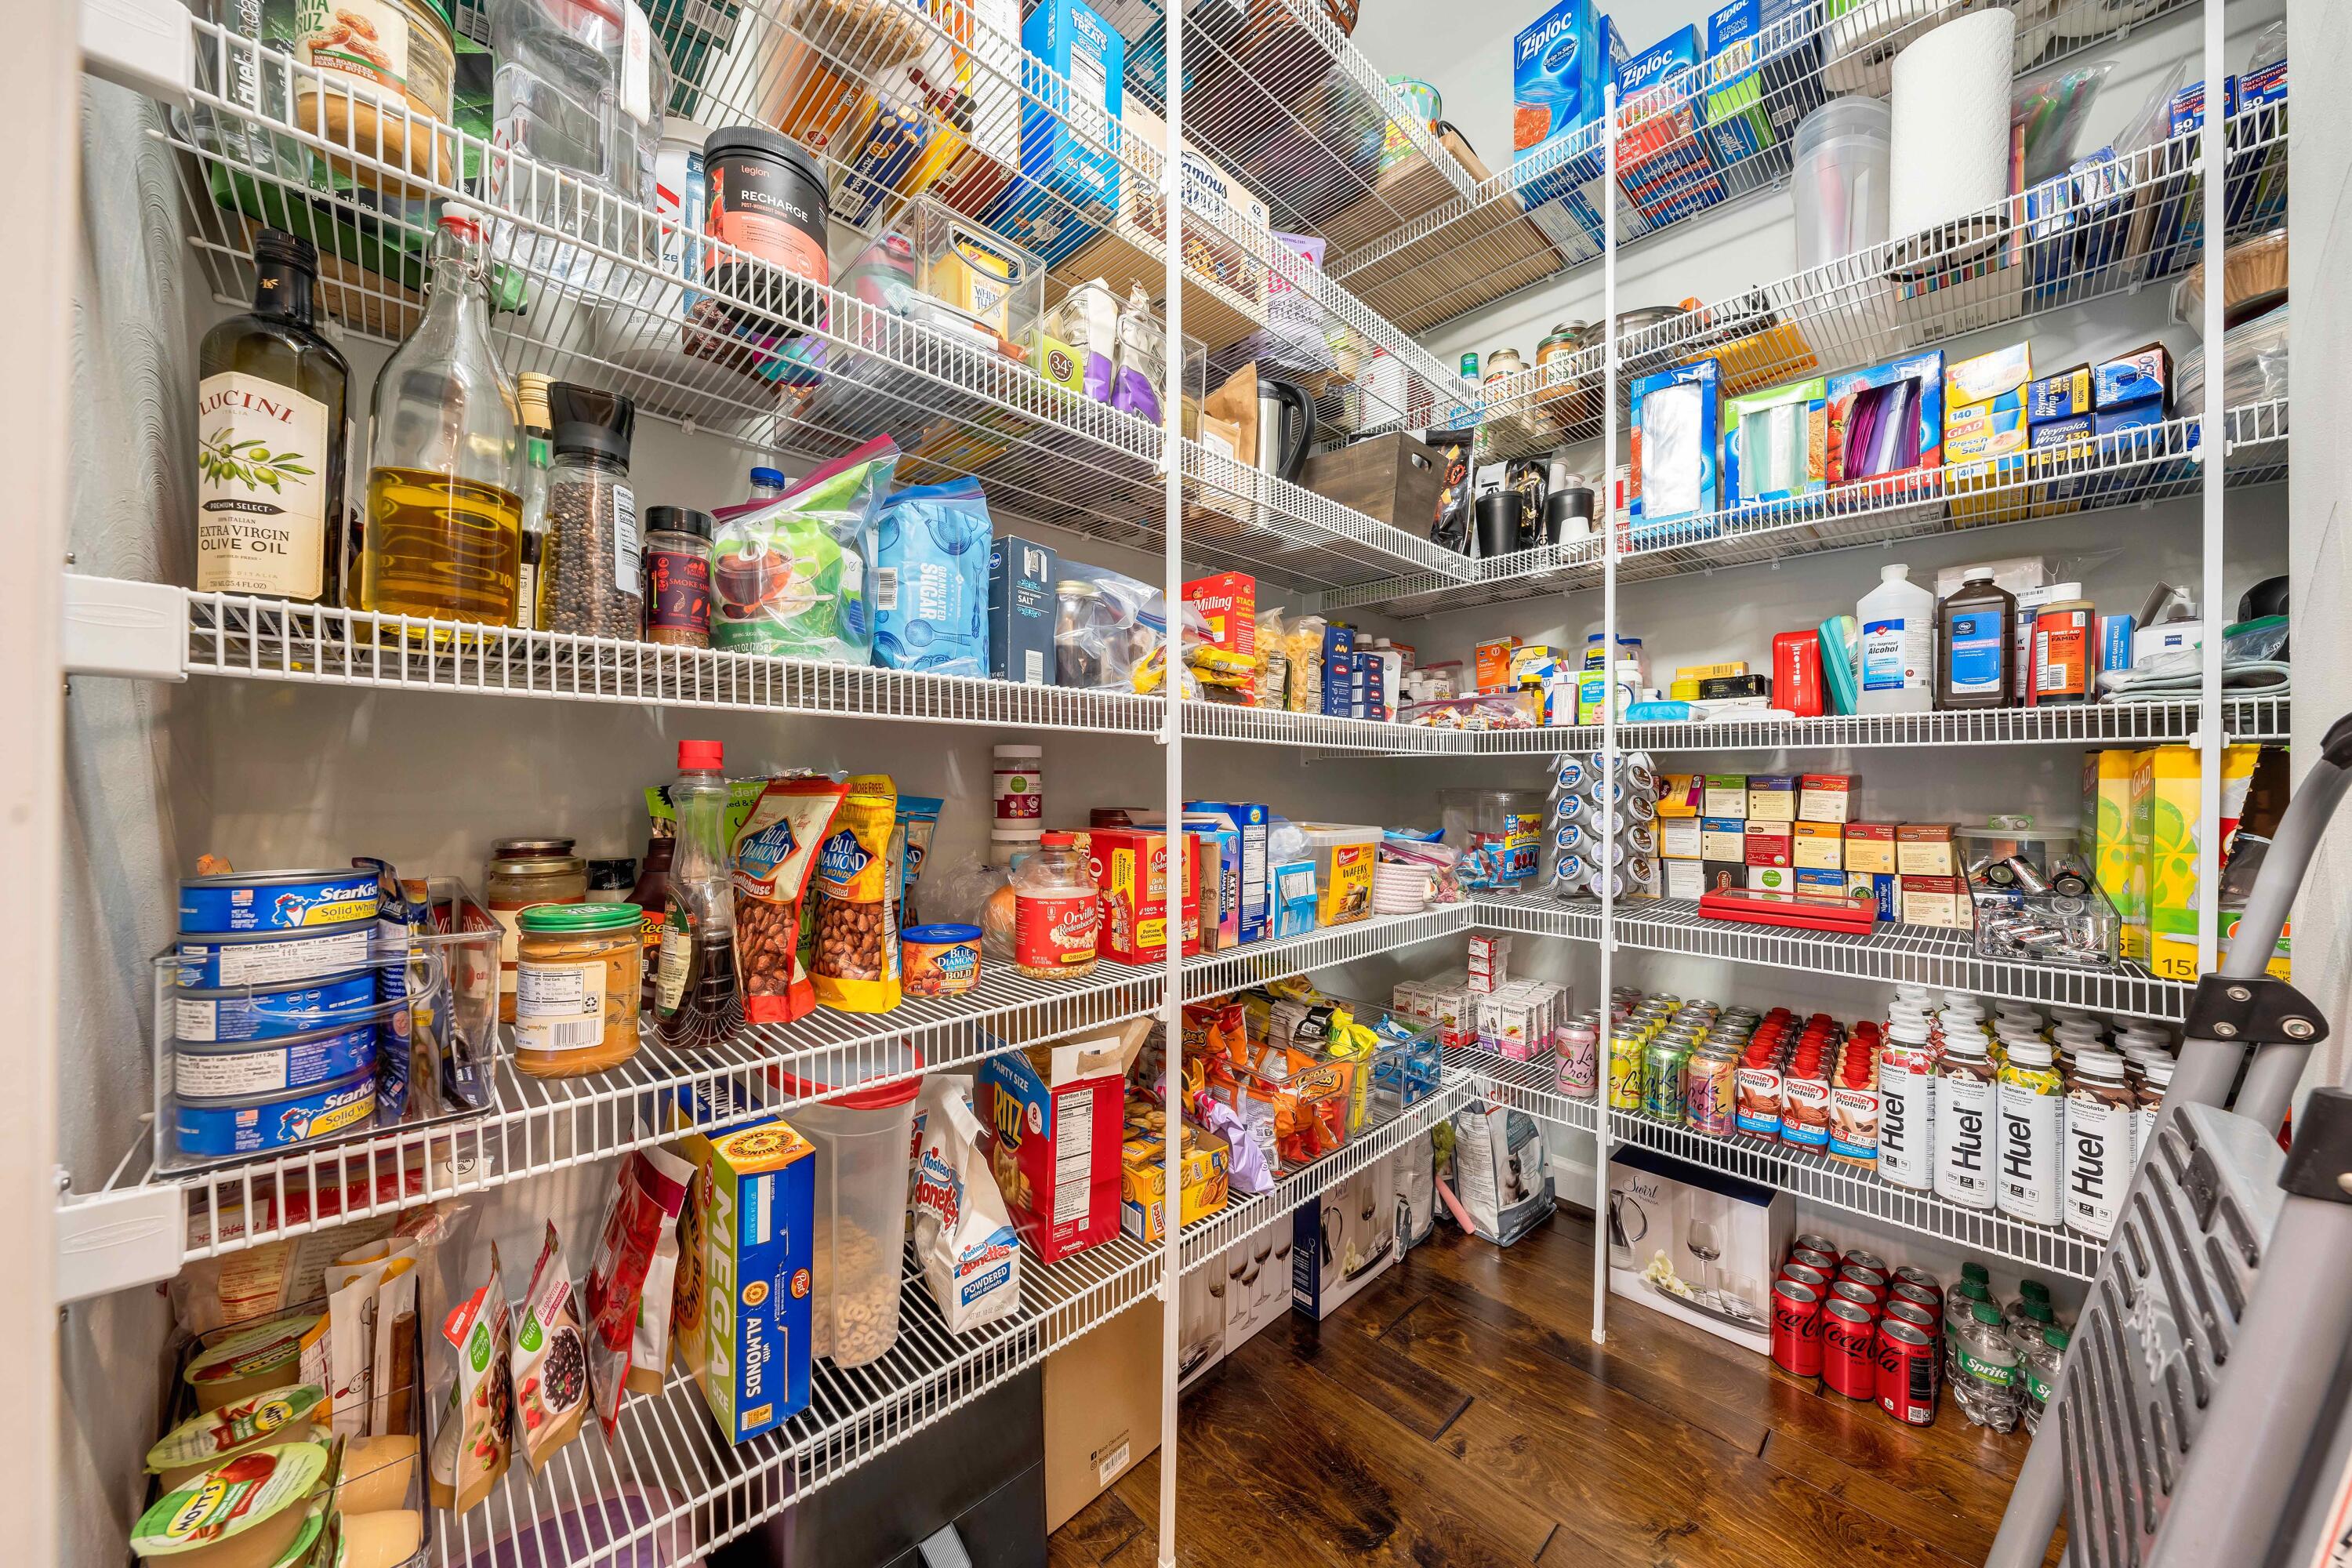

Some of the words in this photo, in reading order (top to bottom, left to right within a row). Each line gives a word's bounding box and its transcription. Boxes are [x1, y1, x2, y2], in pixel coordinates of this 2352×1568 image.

[1072, 16, 1107, 52] TREATS
[1719, 16, 1748, 34] STRONG
[1719, 34, 1730, 43] USE
[1730, 24, 1748, 38] AGAIN
[1521, 13, 1572, 60] Ziploc
[314, 49, 340, 57] Crunchy
[314, 55, 335, 64] DARK
[336, 57, 374, 75] ROASTED
[314, 60, 344, 71] PEANUT
[346, 65, 378, 82] BUTTER
[1622, 50, 1672, 89] Ziploc
[2241, 79, 2267, 93] Paper
[2173, 103, 2198, 115] Paper
[2244, 96, 2263, 111] 50
[2173, 118, 2194, 132] 50
[741, 191, 808, 223] RECHARGE
[1252, 204, 1262, 217] 42
[2138, 355, 2155, 379] 250
[2050, 377, 2062, 396] 130
[2096, 368, 2107, 404] Reynolds
[2107, 381, 2121, 402] Wrap
[199, 389, 296, 424] LUCINI
[2035, 382, 2046, 416] Reynolds
[2045, 395, 2057, 416] Wrap
[1952, 409, 1972, 421] 140
[1947, 420, 1984, 439] GLAD
[2035, 434, 2064, 446] Wrap
[2066, 430, 2090, 442] 130
[2038, 421, 2089, 437] Reynolds
[1948, 436, 1989, 450] Press'n
[1961, 444, 1987, 455] Seal
[210, 502, 234, 510] PREMIUM
[237, 503, 268, 513] SELECT
[200, 524, 229, 538] EXTRA
[231, 524, 290, 542] VIRGIN
[201, 538, 242, 550] OLIVE
[251, 540, 287, 554] OIL
[669, 579, 698, 589] SMOKE
[920, 563, 934, 621] SUGAR
[937, 564, 947, 622] GRANULATED
[1018, 596, 1034, 605] SALT
[1192, 595, 1232, 612] Milling
[1236, 596, 1254, 608] STACK
[1867, 645, 1899, 655] Alcohol
[851, 782, 868, 793] MORE
[868, 781, 885, 793] FREE!
[2083, 764, 2096, 793] GLAD
[2132, 764, 2151, 797] GLAD
[761, 824, 789, 847] BLUE
[829, 833, 856, 854] BLUE
[739, 838, 790, 864] DIAMOND
[1342, 863, 1367, 879] WAFERS
[732, 873, 774, 896] mokehouse
[826, 882, 849, 898] Roasted
[321, 905, 352, 918] Solid
[354, 902, 376, 914] White
[327, 912, 361, 920] ALBACORE
[1064, 906, 1095, 925] Orville
[937, 953, 978, 967] DIAMOND
[950, 948, 971, 959] BLUE
[1068, 952, 1093, 961] ORIGINAL
[945, 970, 971, 980] BOLD
[1394, 987, 1412, 996] Honest
[1415, 991, 1434, 1001] Honest
[1437, 996, 1457, 1005] Honest
[1503, 1006, 1526, 1017] Honest
[1577, 1044, 1593, 1067] La
[993, 1060, 1013, 1083] PARTY
[1014, 1073, 1029, 1093] SIZE
[1559, 1058, 1595, 1084] Croix
[1739, 1070, 1770, 1083] Premier
[1740, 1076, 1768, 1089] Protein
[1786, 1080, 1820, 1094] Premier
[1952, 1080, 1984, 1090] Chocolate
[2004, 1086, 2027, 1096] Banana
[1058, 1092, 1079, 1102] Nutrition
[1787, 1086, 1817, 1099] Protein
[1835, 1091, 1871, 1106] Premier
[994, 1080, 1025, 1146] RITZ
[1033, 1106, 1038, 1120] 8
[1738, 1106, 1752, 1116] 30g
[1835, 1097, 1868, 1111] Protein
[2071, 1099, 2106, 1112] Chocolate
[325, 1108, 354, 1126] Solid
[1029, 1118, 1042, 1130] stacks
[1785, 1117, 1798, 1127] 30g
[1882, 1090, 1904, 1152] Huel
[735, 1131, 765, 1145] OATS
[1833, 1129, 1846, 1139] 30g
[1951, 1105, 1983, 1171] Huel
[2002, 1112, 2032, 1181] Huel
[922, 1149, 951, 1179] Hostess
[2071, 1127, 2104, 1200] Huel
[1623, 1175, 1658, 1199] Swirl
[1152, 1203, 1166, 1233] Lance
[960, 1244, 1011, 1276] donettes
[962, 1244, 987, 1261] Hostess
[709, 1185, 732, 1377] MEGA
[792, 1270, 810, 1295] Post
[964, 1266, 1007, 1296] POWDERED
[969, 1288, 982, 1300] mini
[983, 1279, 1003, 1294] donuts
[538, 1280, 561, 1318] Raspberries
[471, 1330, 486, 1355] simple
[521, 1322, 538, 1345] truth
[474, 1338, 490, 1363] truth
[745, 1317, 763, 1399] ALMONDS
[1966, 1359, 2009, 1379] Sprite
[711, 1379, 729, 1414] SIZE
